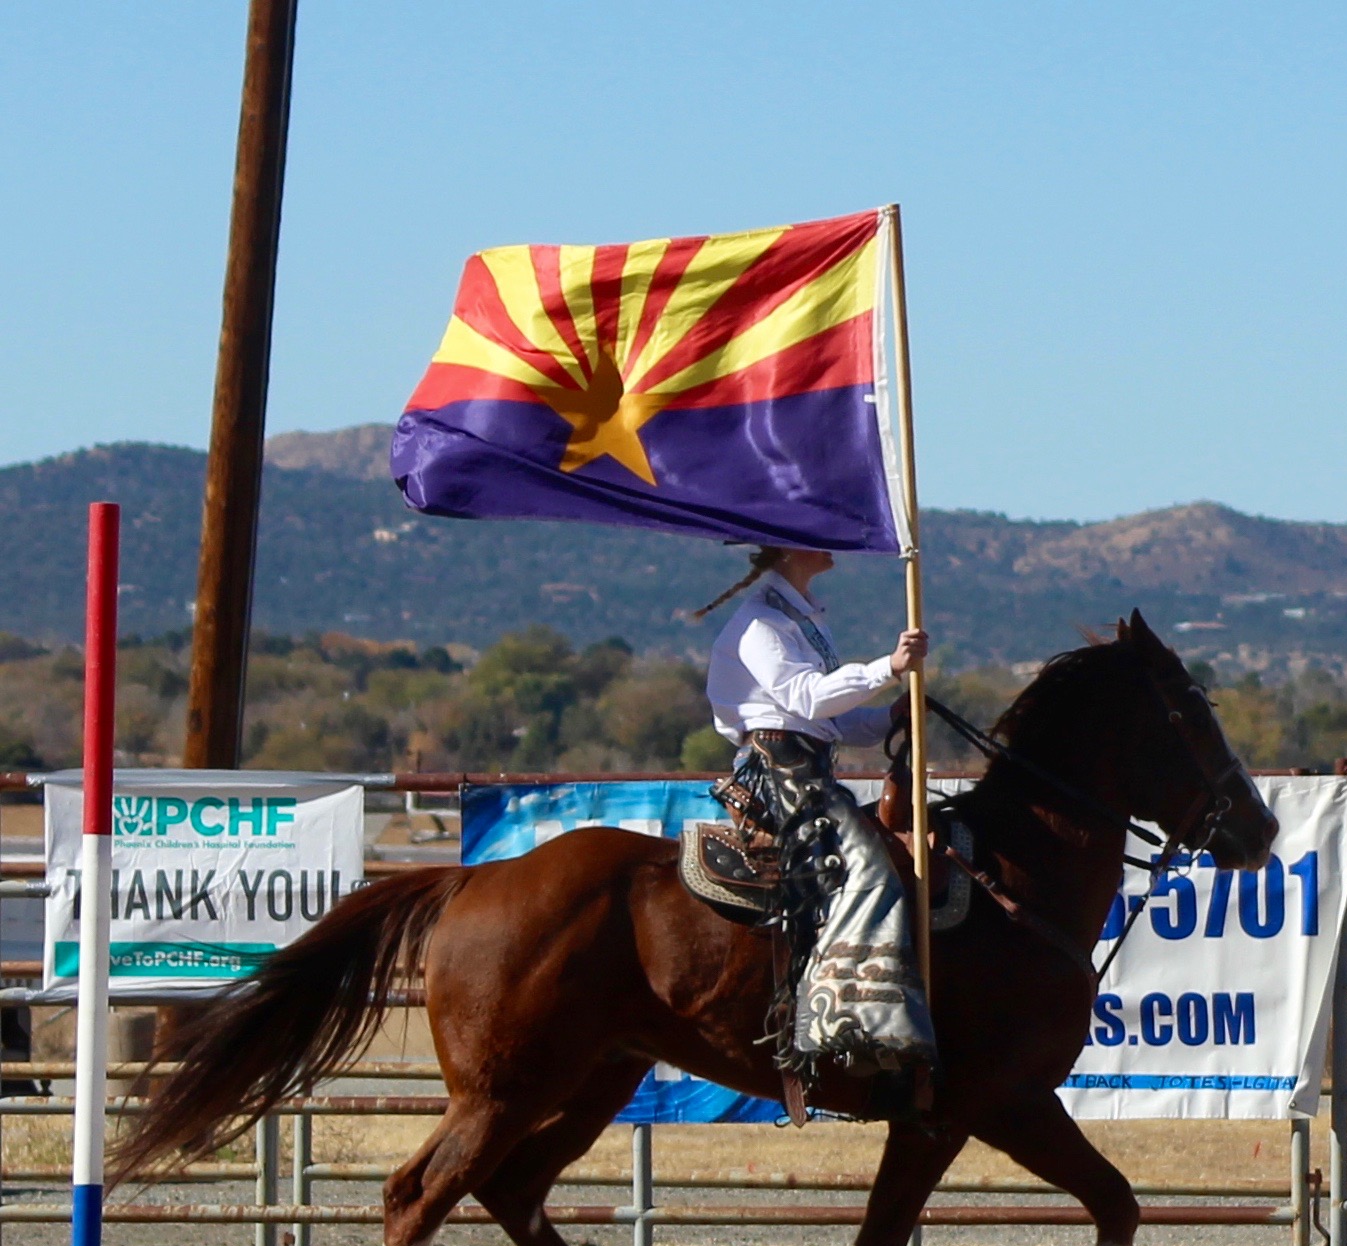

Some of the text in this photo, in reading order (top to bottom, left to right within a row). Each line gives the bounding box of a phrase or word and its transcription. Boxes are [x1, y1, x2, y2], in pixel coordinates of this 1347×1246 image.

[156, 796, 297, 837] PCHF
[114, 839, 151, 849] Phoenix
[155, 839, 199, 849] Children's
[203, 839, 240, 850] Hospital
[110, 951, 241, 972] veToPCHF.org
[1085, 1074, 1132, 1090] BACK
